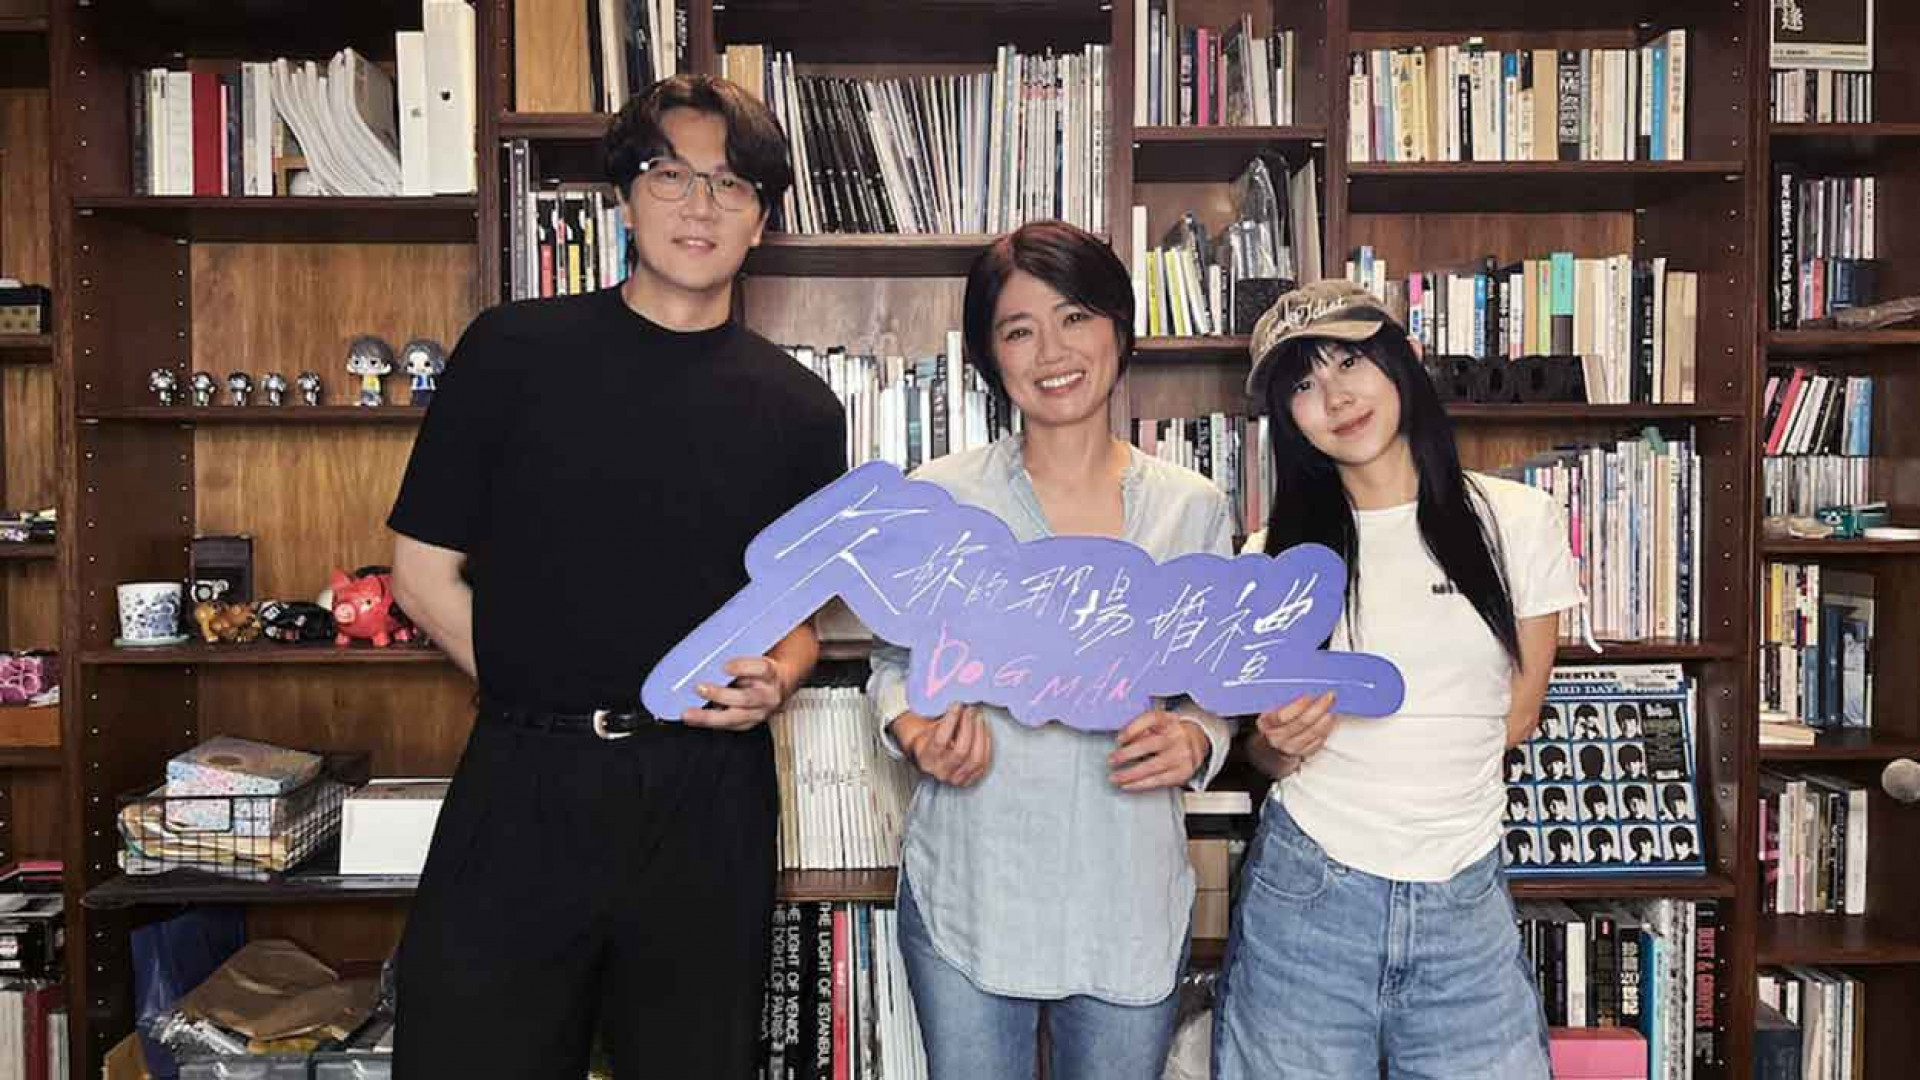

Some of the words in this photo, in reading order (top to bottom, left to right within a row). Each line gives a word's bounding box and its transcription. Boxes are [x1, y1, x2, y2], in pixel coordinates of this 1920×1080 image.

[1549, 685, 1581, 694] ARD
[817, 931, 832, 972] LIGHT
[785, 972, 799, 992] OF
[817, 977, 832, 998] OF
[784, 995, 799, 1045] VENICE
[816, 1002, 832, 1069] ISTANBUL
